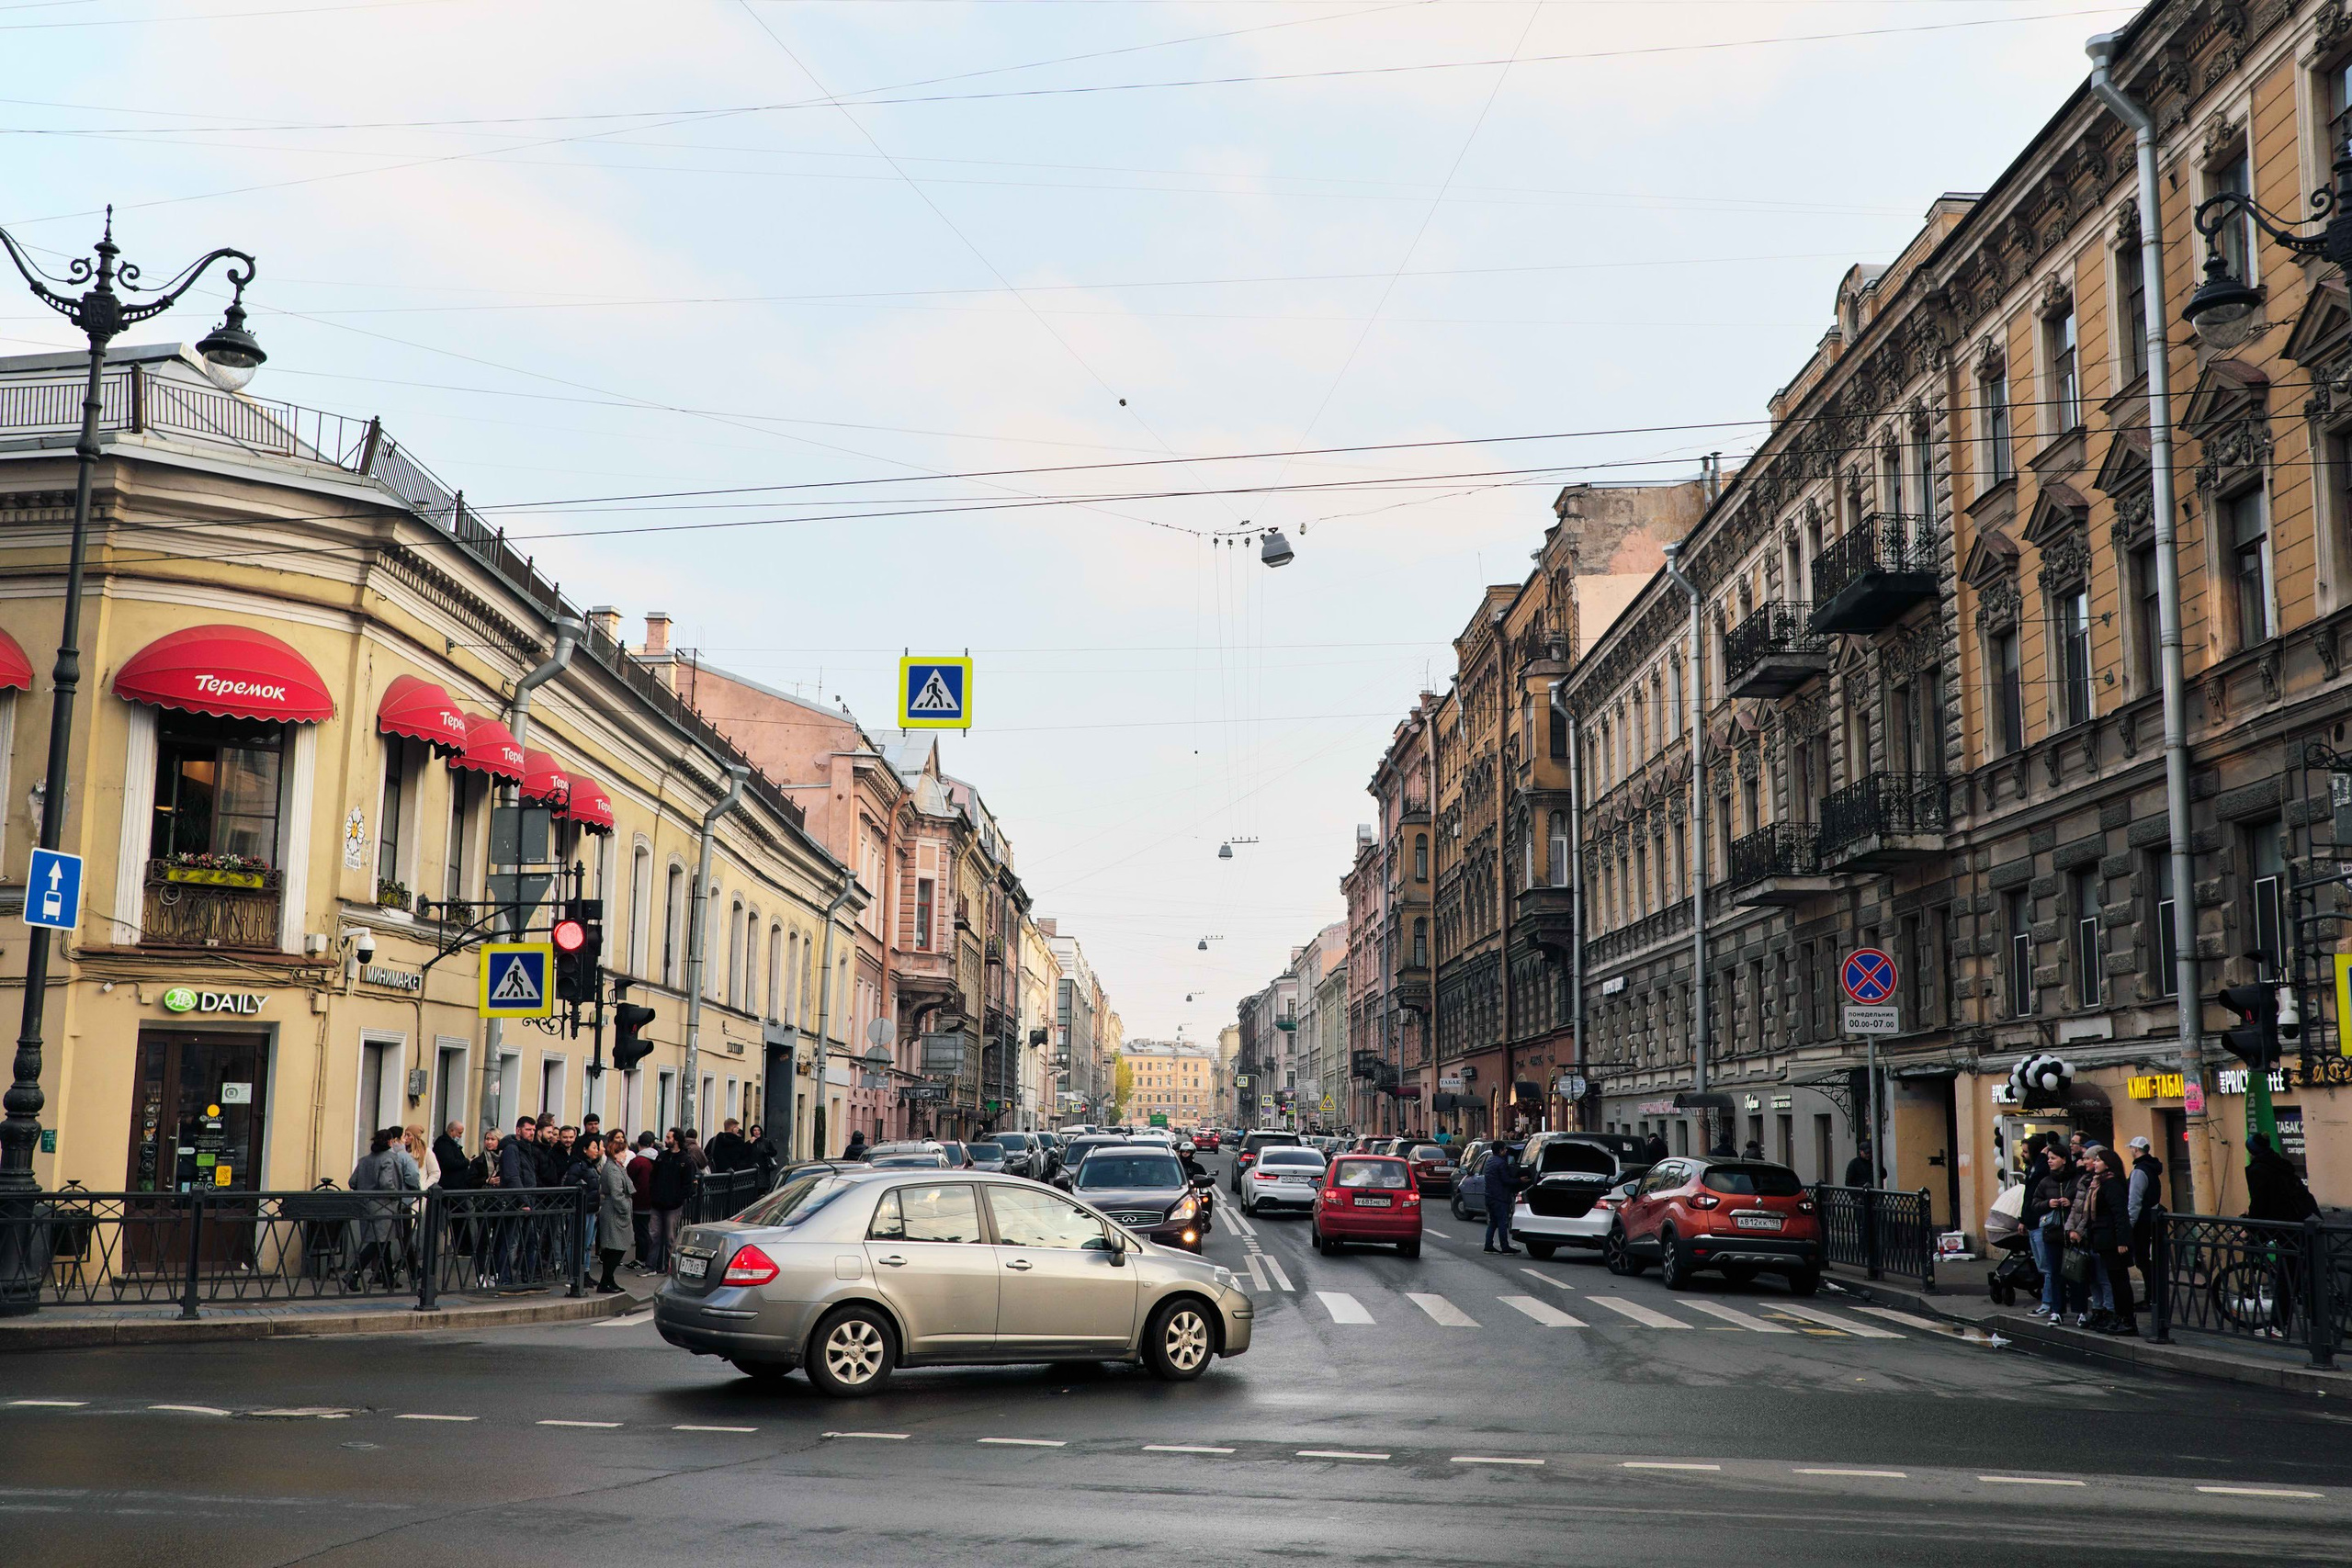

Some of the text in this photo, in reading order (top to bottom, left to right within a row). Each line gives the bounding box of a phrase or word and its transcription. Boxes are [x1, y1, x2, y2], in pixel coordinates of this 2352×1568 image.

[195, 674, 286, 701] Теремок
[366, 965, 423, 990] МИНИМАРКЕТ
[201, 992, 270, 1013] DAILY
[2276, 1121, 2300, 1134] ТАБАК
